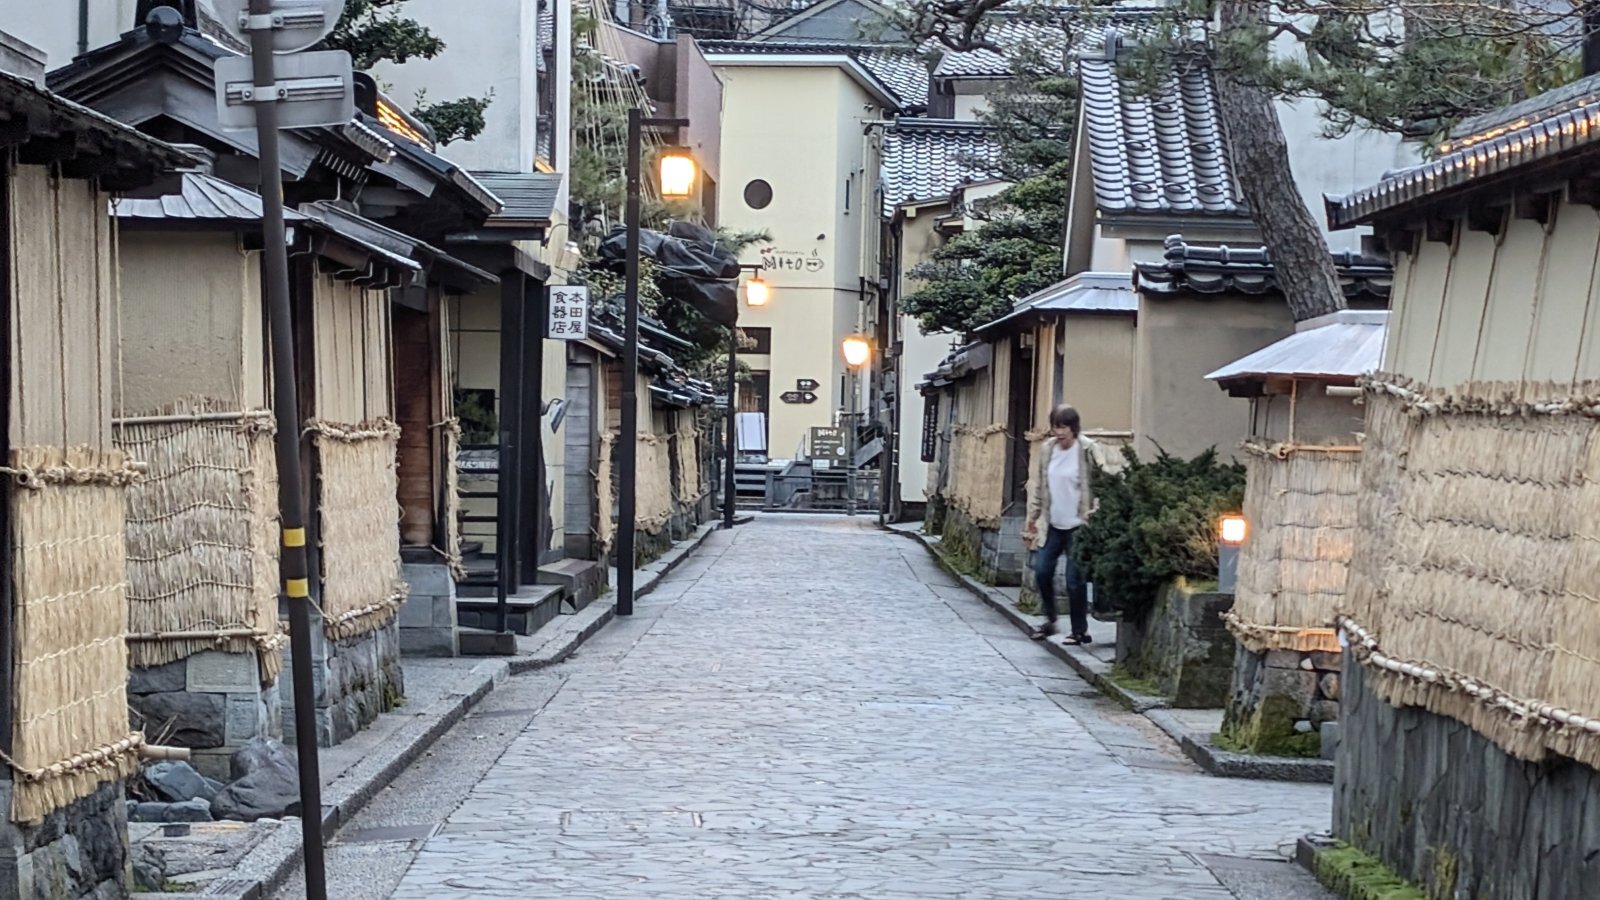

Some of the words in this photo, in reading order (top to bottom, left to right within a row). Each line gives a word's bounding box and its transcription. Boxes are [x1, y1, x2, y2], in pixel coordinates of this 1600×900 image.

[551, 291, 568, 334] 食器店
[568, 291, 585, 334] 本田屋
